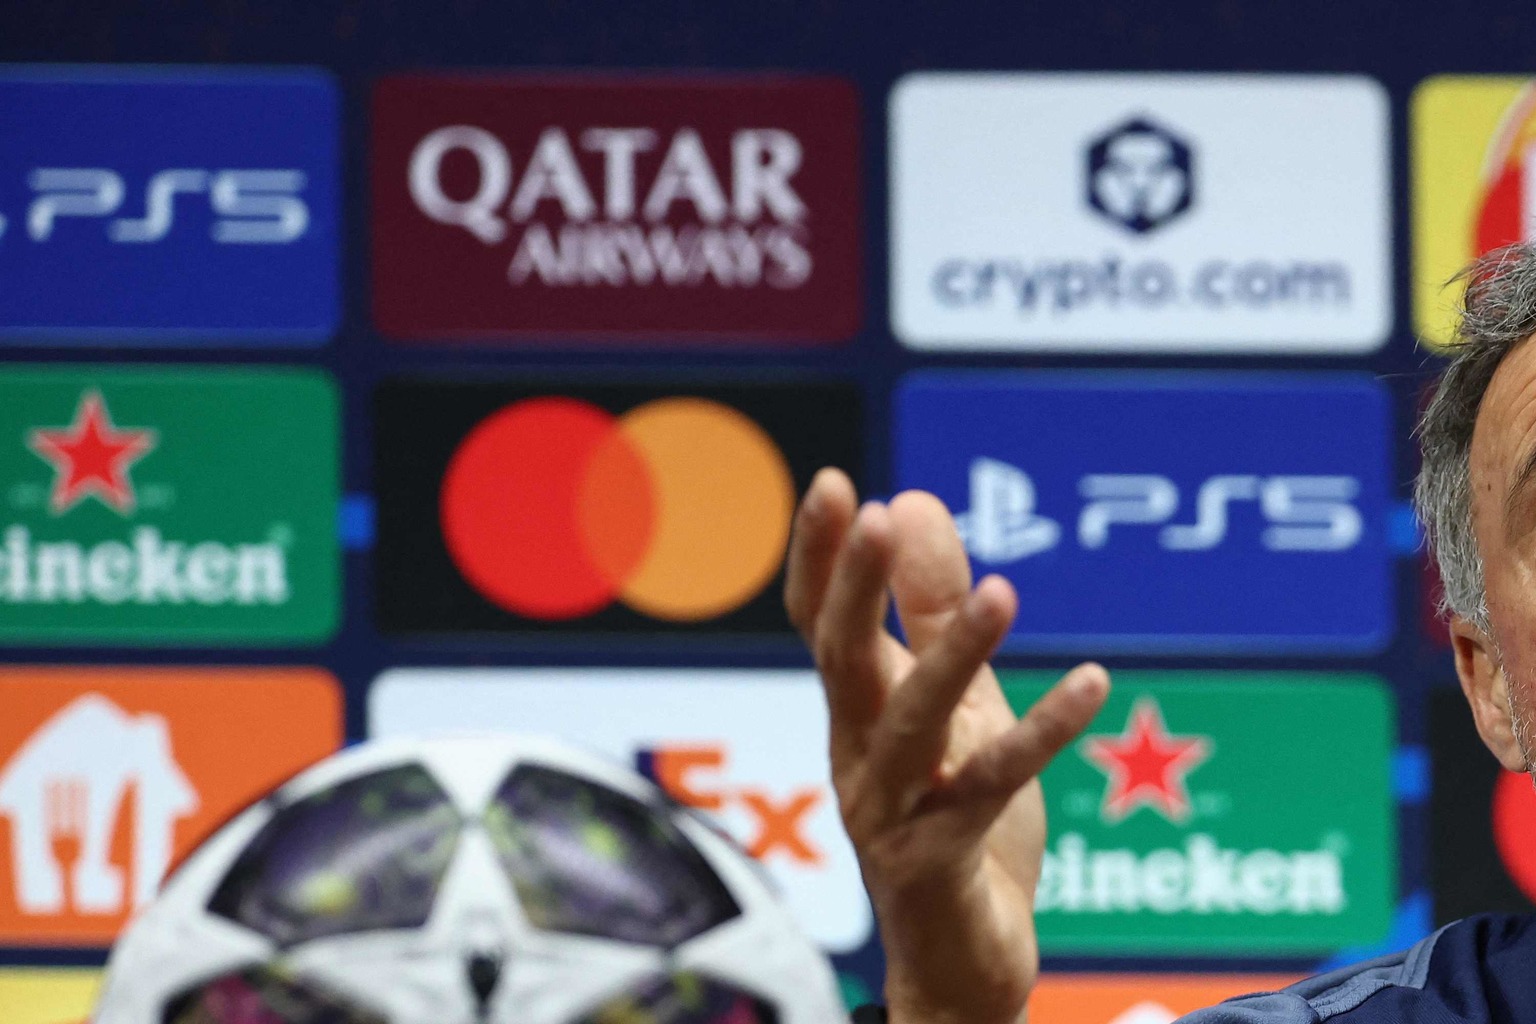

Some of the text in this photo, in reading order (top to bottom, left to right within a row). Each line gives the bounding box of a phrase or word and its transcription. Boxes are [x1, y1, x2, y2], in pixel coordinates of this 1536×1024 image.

[26, 167, 310, 244] PS5
[408, 124, 808, 245] QATAR
[507, 222, 814, 291] AIRWAYS
[930, 254, 1354, 323] crypto.com
[1076, 473, 1363, 552] PS5
